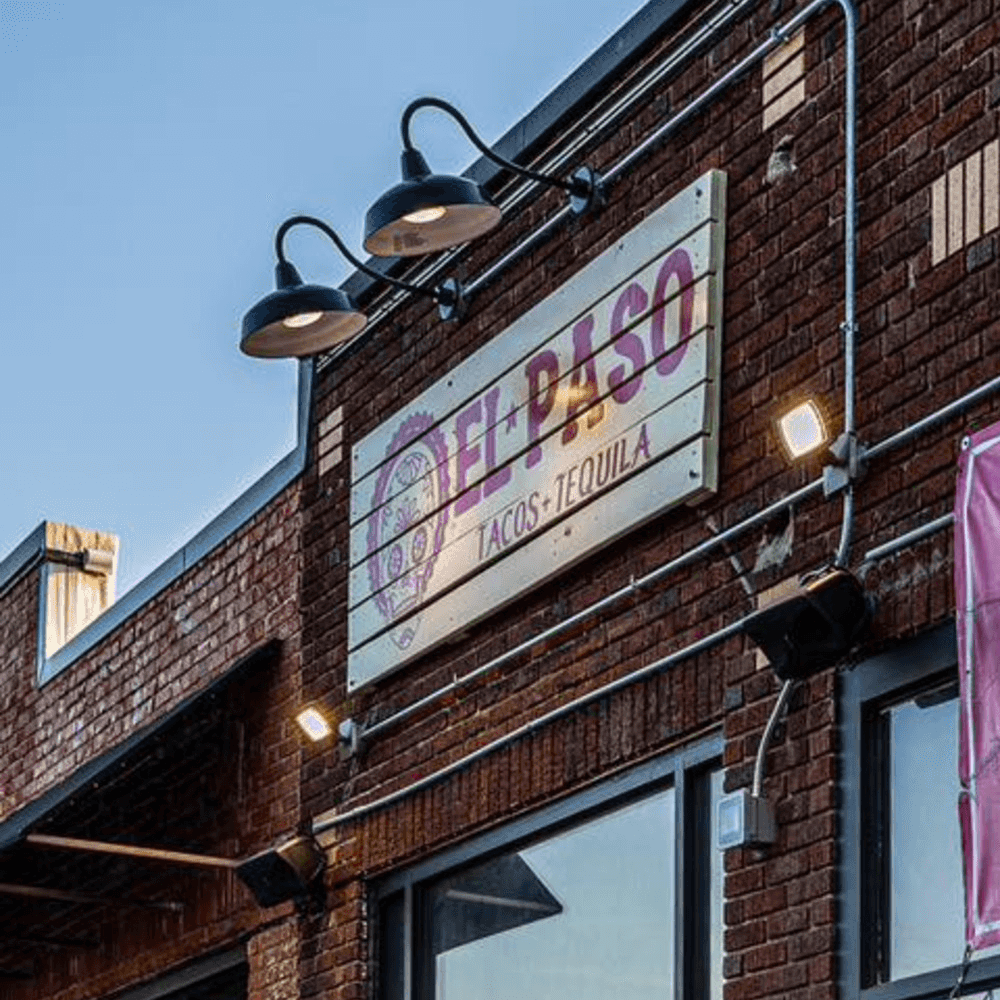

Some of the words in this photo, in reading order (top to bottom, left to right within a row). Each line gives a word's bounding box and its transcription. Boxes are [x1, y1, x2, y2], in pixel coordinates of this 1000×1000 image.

[454, 386, 512, 517] EL
[525, 247, 695, 470] PASO
[477, 491, 540, 561] TACOS
[554, 423, 651, 513] TEQUILA
